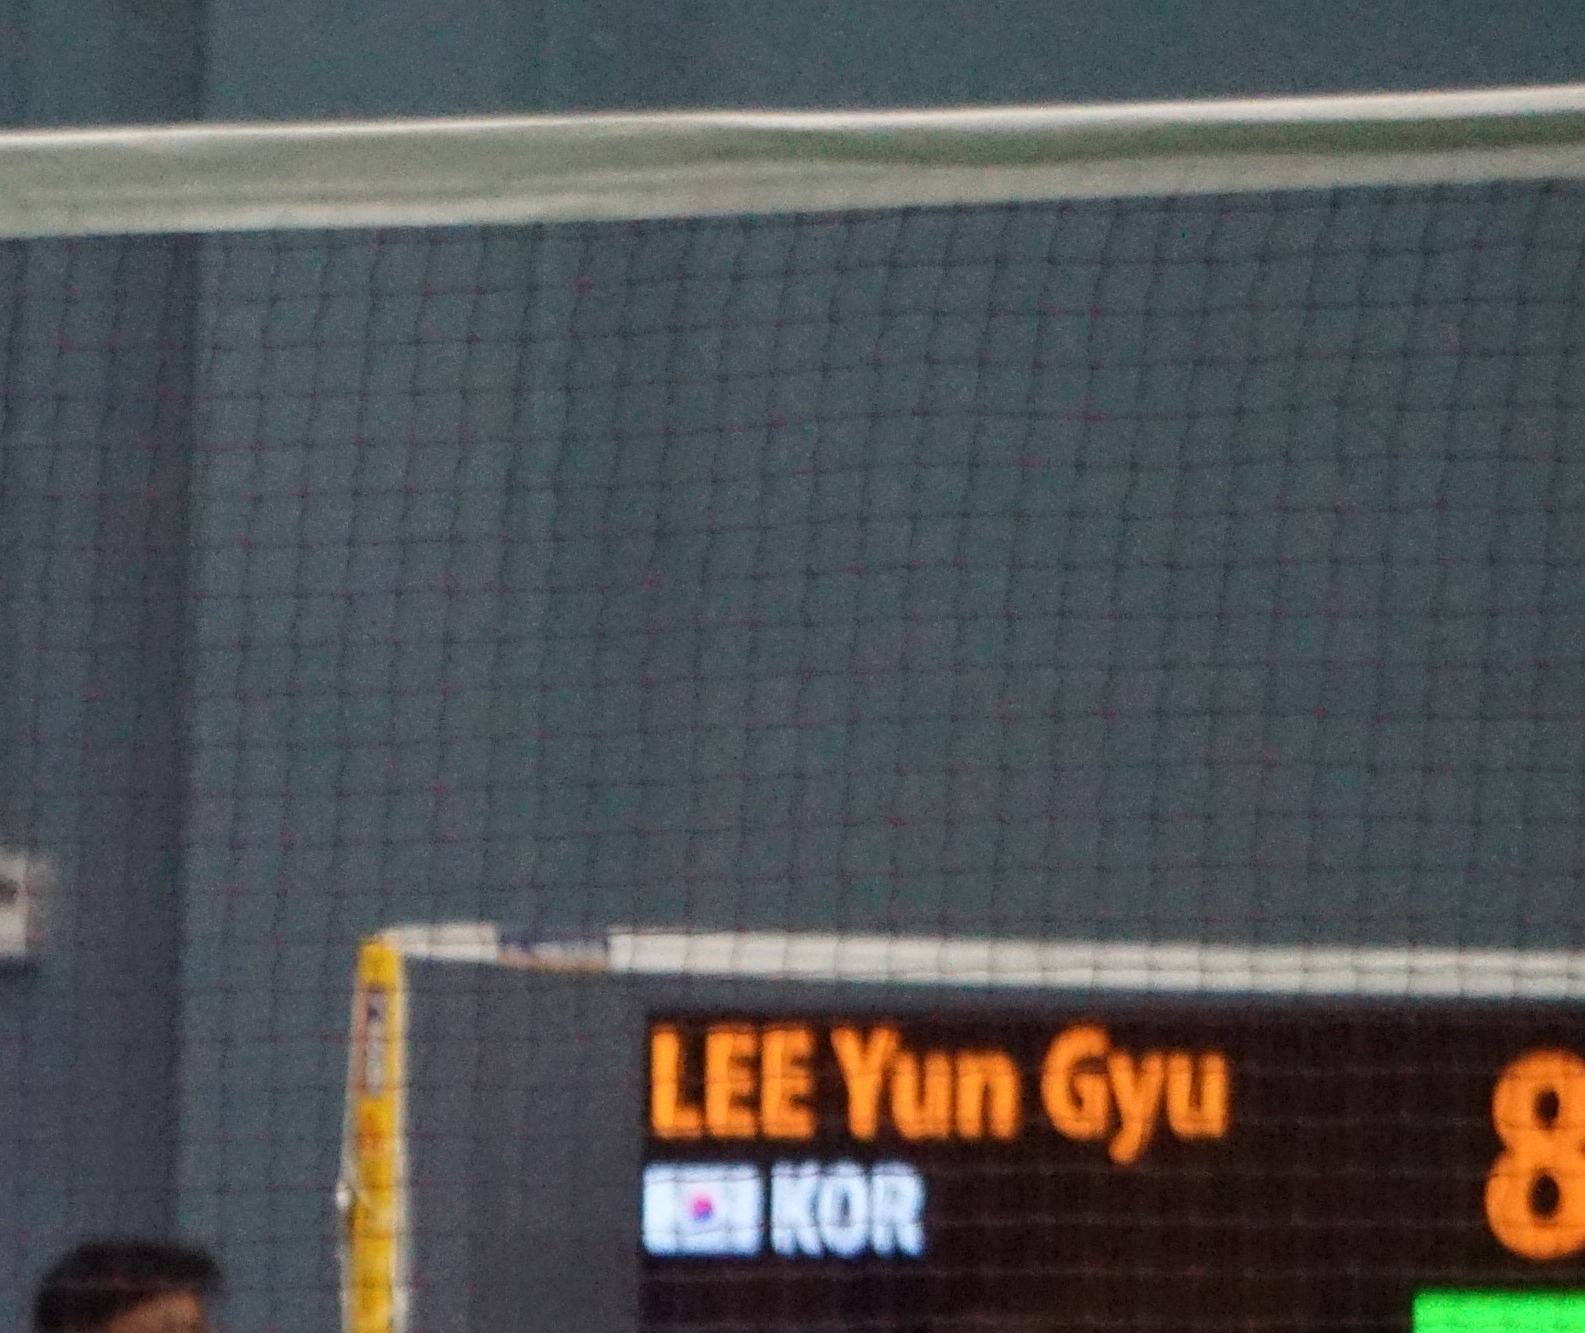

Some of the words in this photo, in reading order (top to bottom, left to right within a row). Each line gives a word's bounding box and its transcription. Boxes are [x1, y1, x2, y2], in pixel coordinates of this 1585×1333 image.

[649, 1023, 816, 1141] LEE
[831, 1025, 1020, 1142] Yun
[1040, 1022, 1228, 1165] Gyu
[1484, 1047, 1585, 1260] 8
[770, 1162, 927, 1258] KOR
